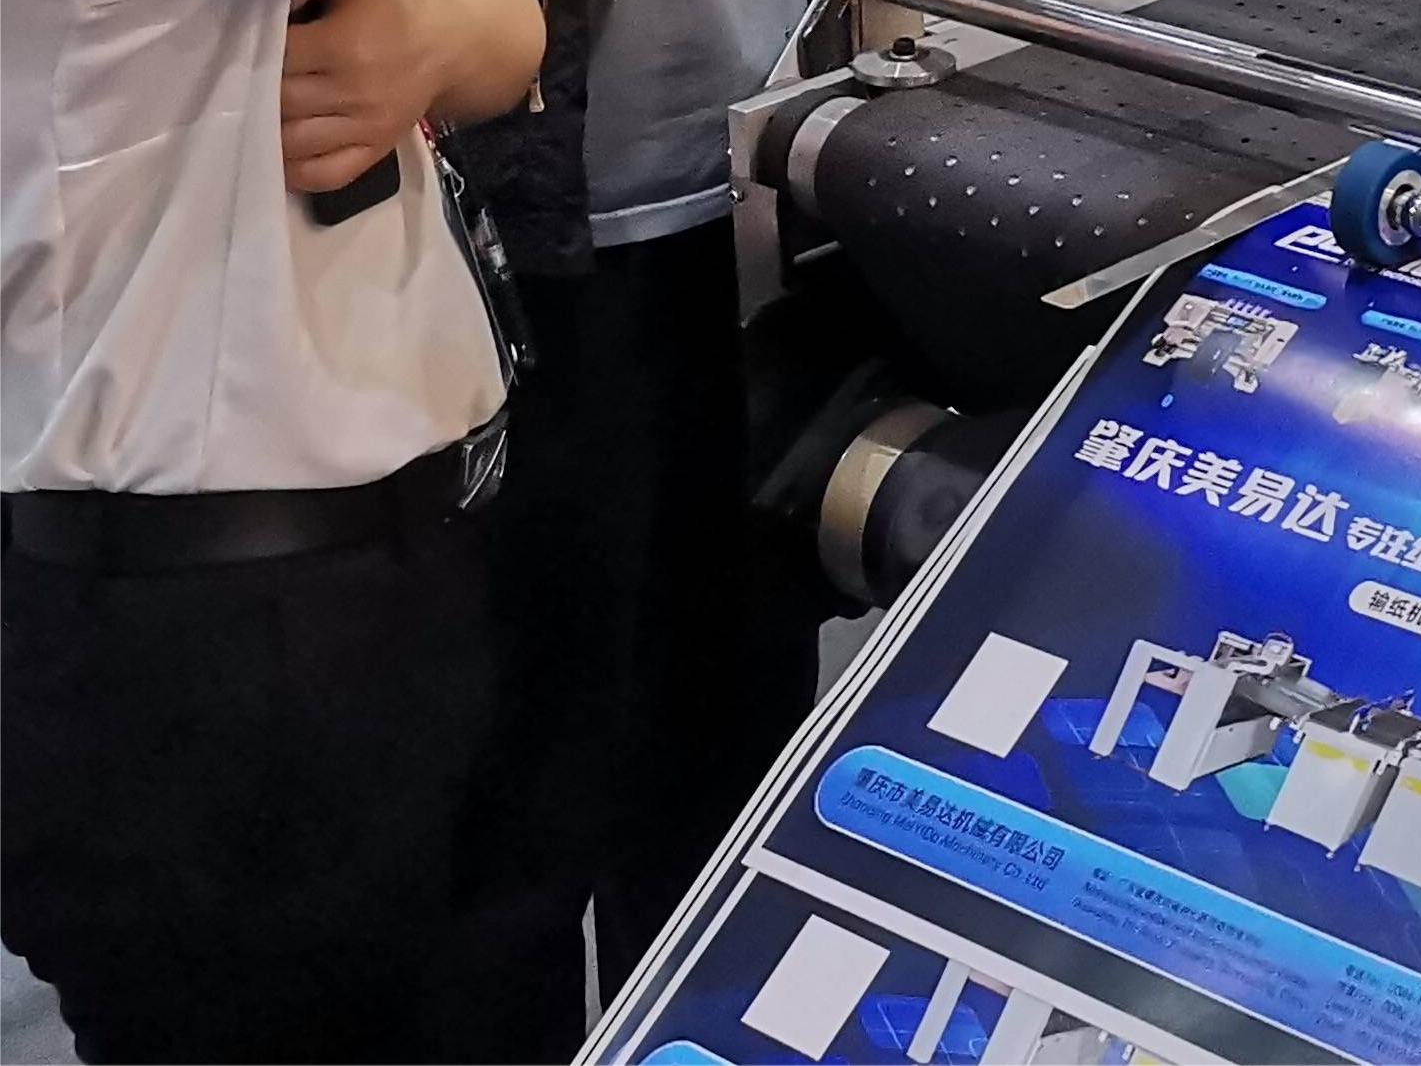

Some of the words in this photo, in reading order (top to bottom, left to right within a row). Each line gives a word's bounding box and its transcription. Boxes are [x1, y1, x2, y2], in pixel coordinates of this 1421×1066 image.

[1074, 418, 1351, 543] 肇庆美易达
